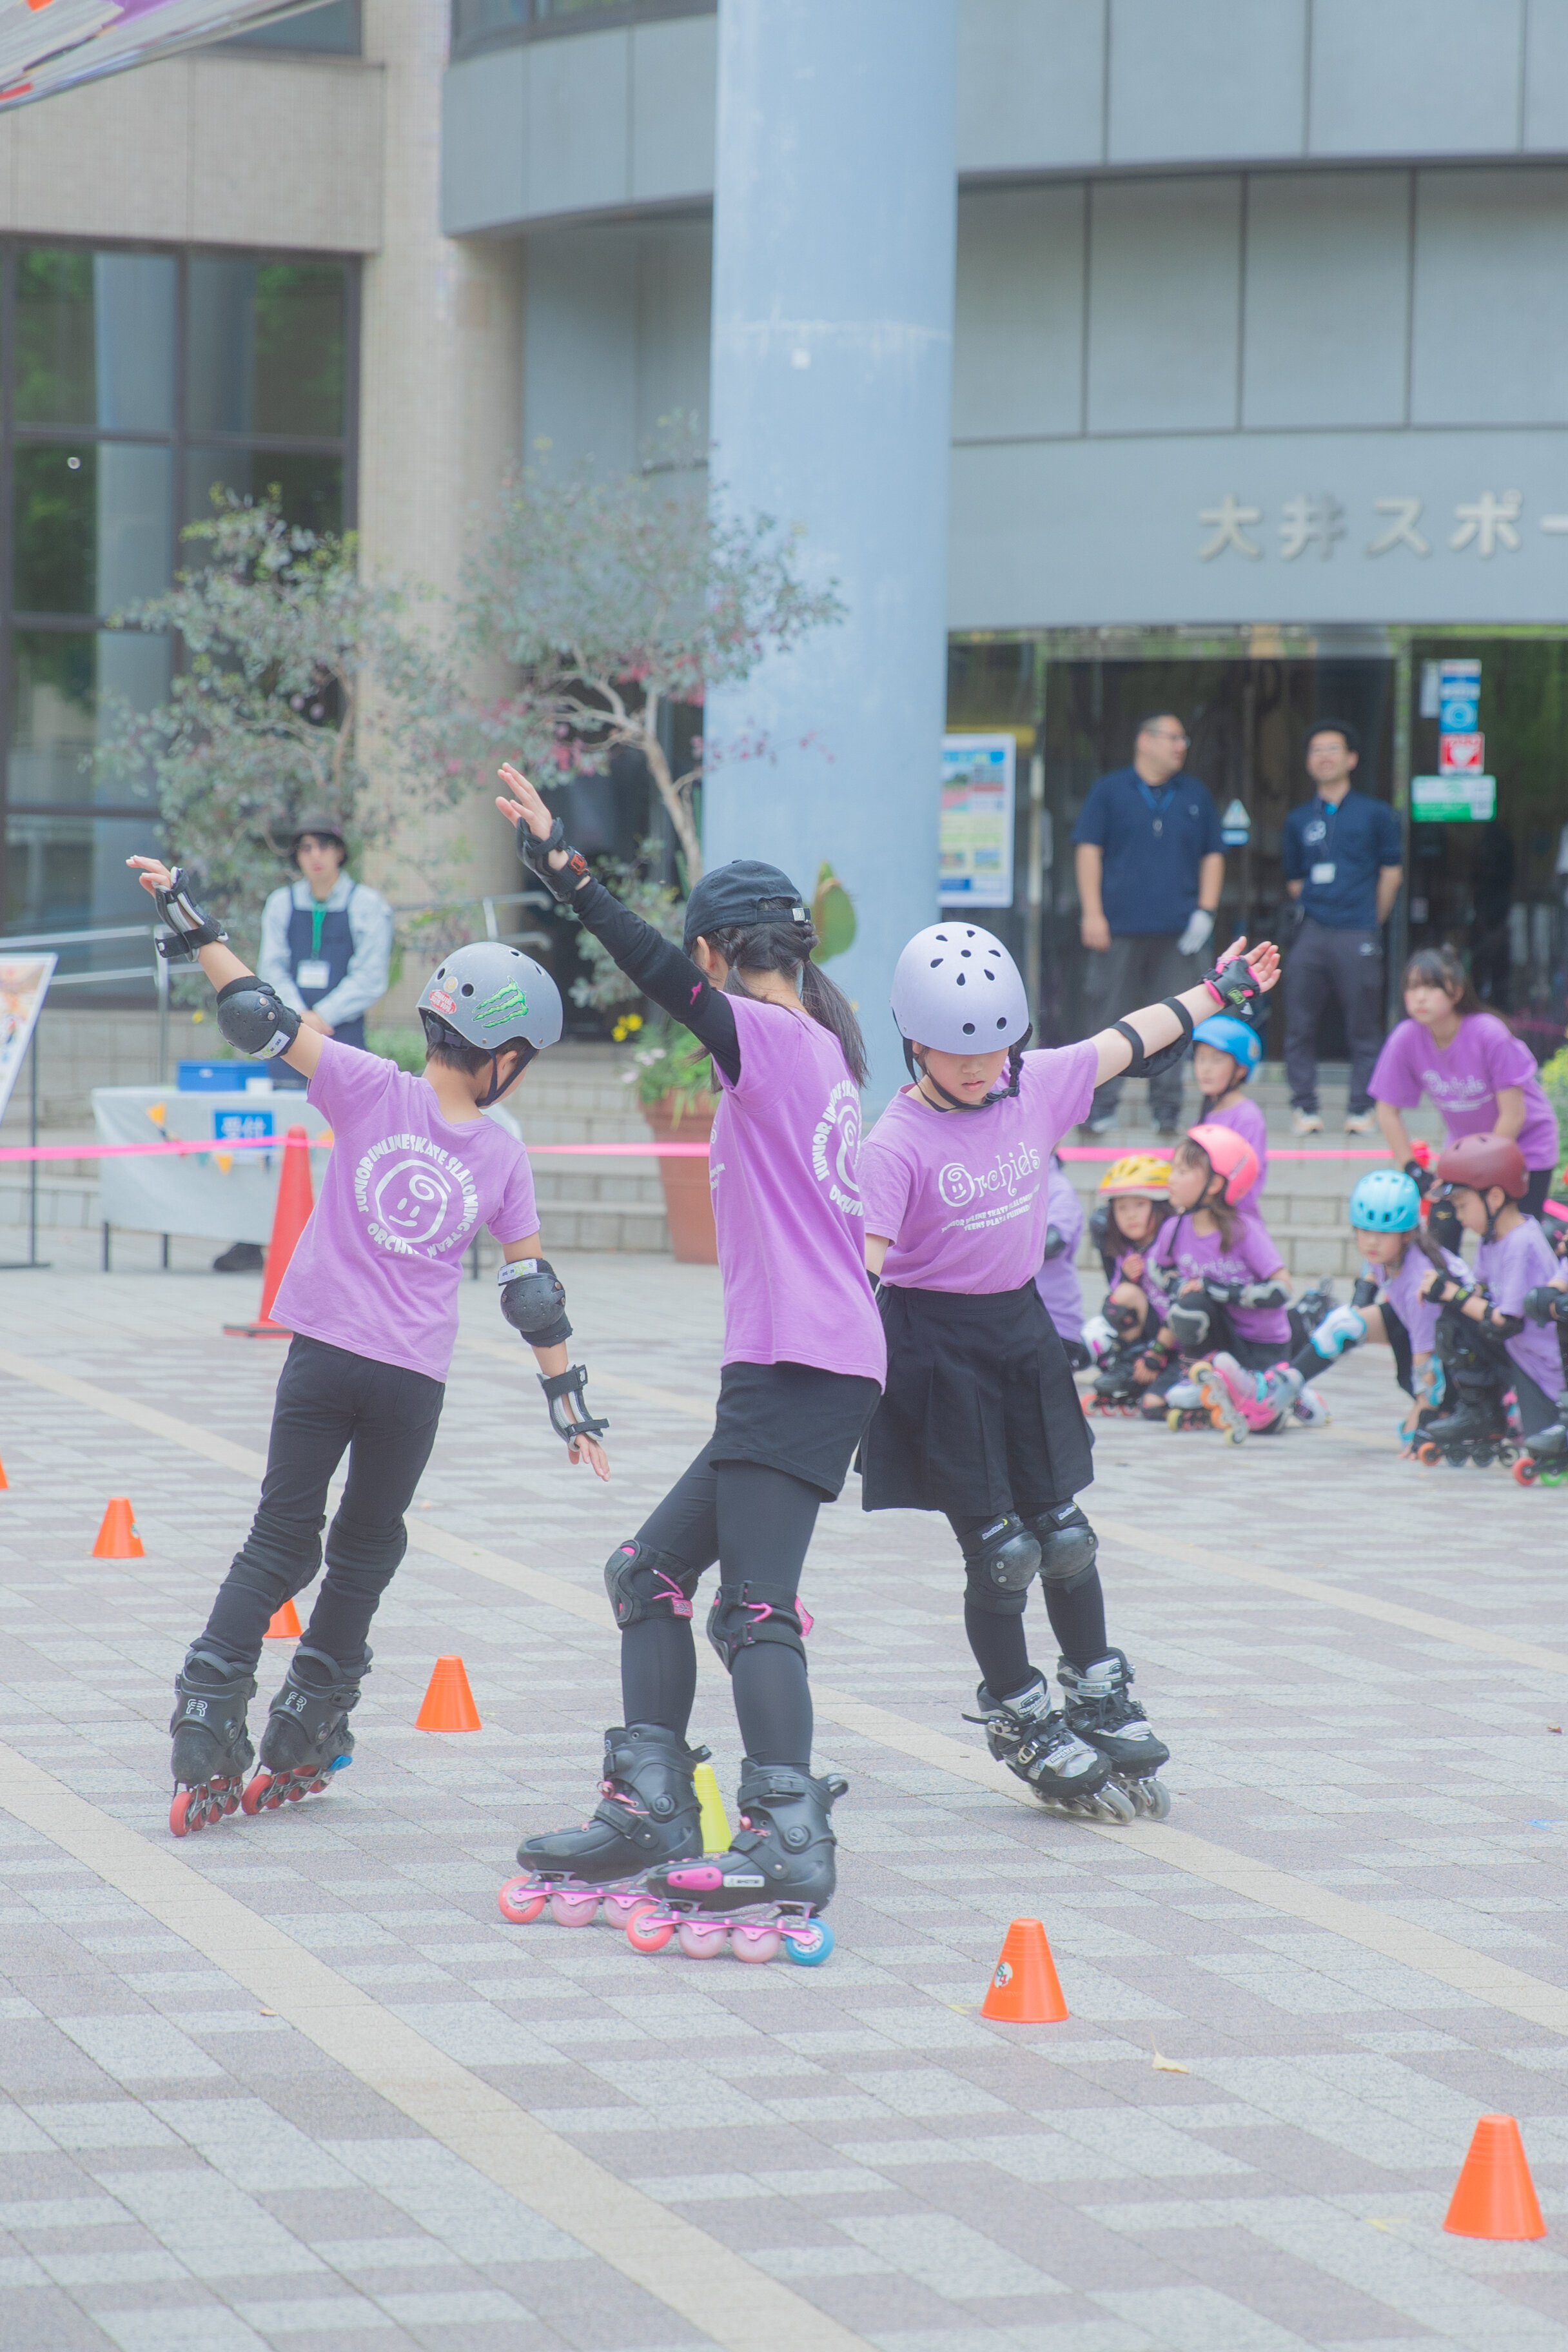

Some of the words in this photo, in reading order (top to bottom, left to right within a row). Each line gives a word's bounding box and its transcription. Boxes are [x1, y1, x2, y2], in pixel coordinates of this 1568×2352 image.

[812, 1121, 832, 1182] JUNIOR
[938, 1141, 1041, 1208] Orchids
[355, 1157, 374, 1212] JUNIOR
[445, 1157, 478, 1231] SLALOMING
[427, 1232, 463, 1259] TEAM
